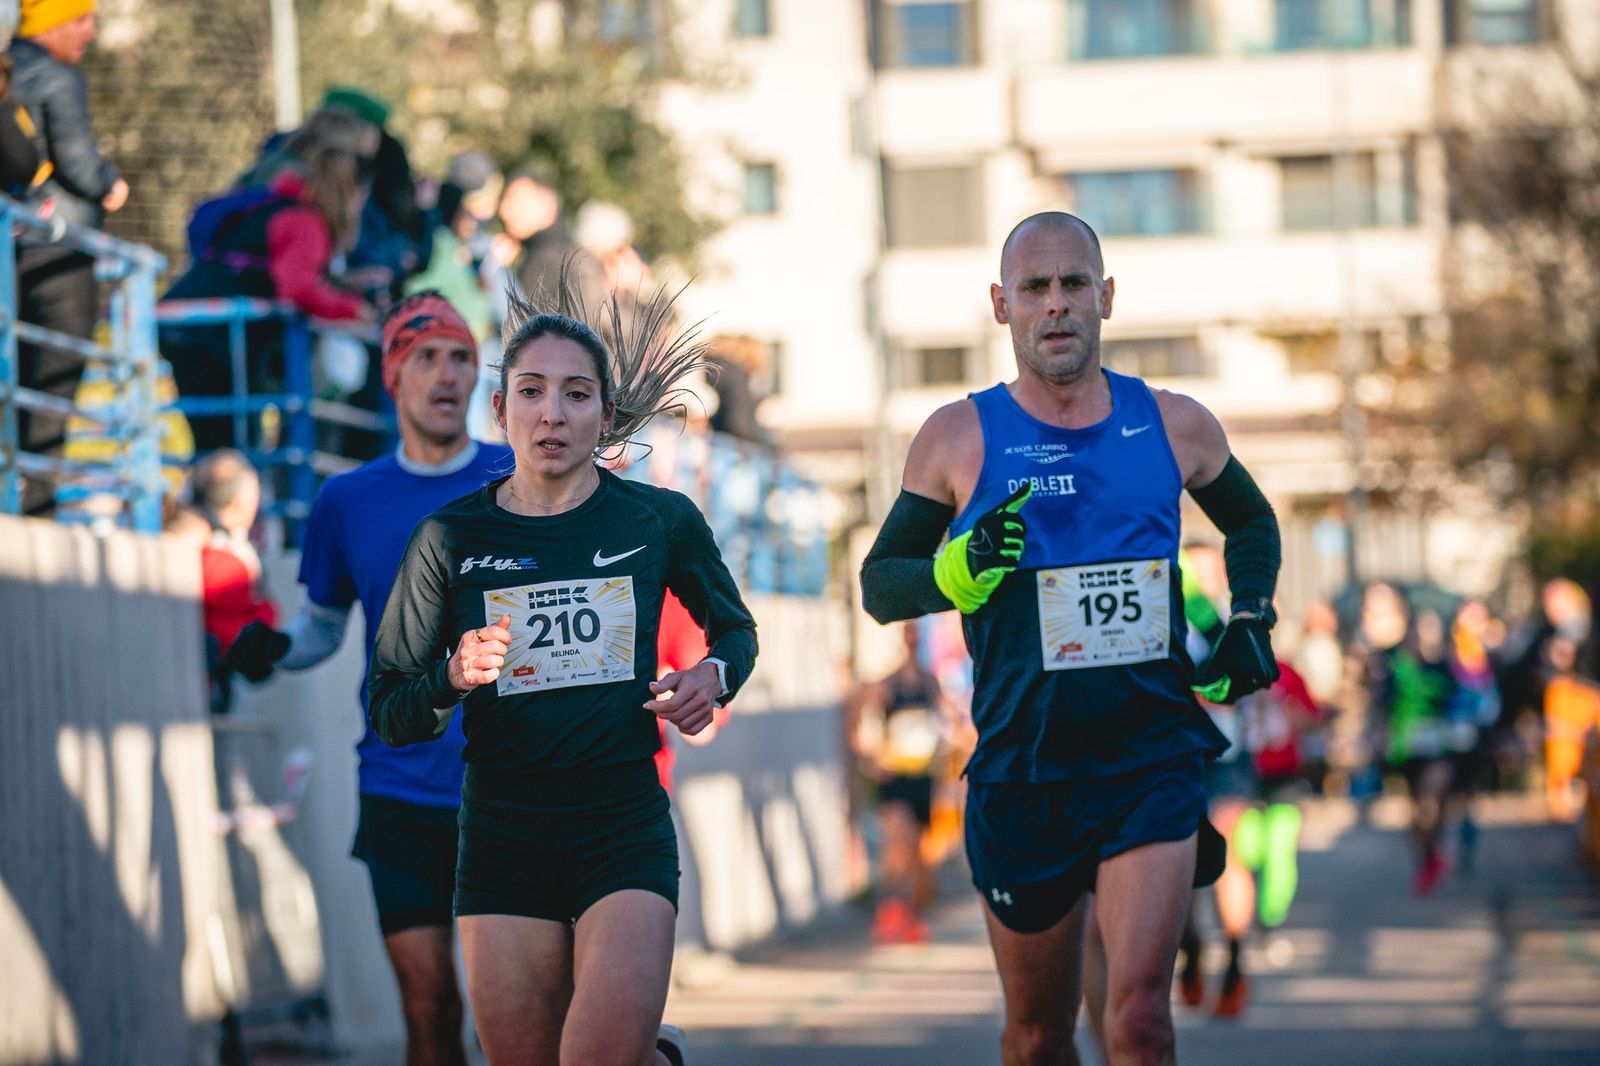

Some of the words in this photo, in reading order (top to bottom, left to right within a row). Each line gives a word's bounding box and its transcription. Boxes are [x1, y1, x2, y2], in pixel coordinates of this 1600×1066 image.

[1005, 445, 1033, 455] JESUS
[1034, 443, 1068, 452] CARRO
[1080, 568, 1135, 589] 10K
[528, 586, 590, 609] 10K
[1078, 590, 1142, 626] 195
[526, 608, 601, 649] 210
[551, 648, 581, 658] BELINDA
